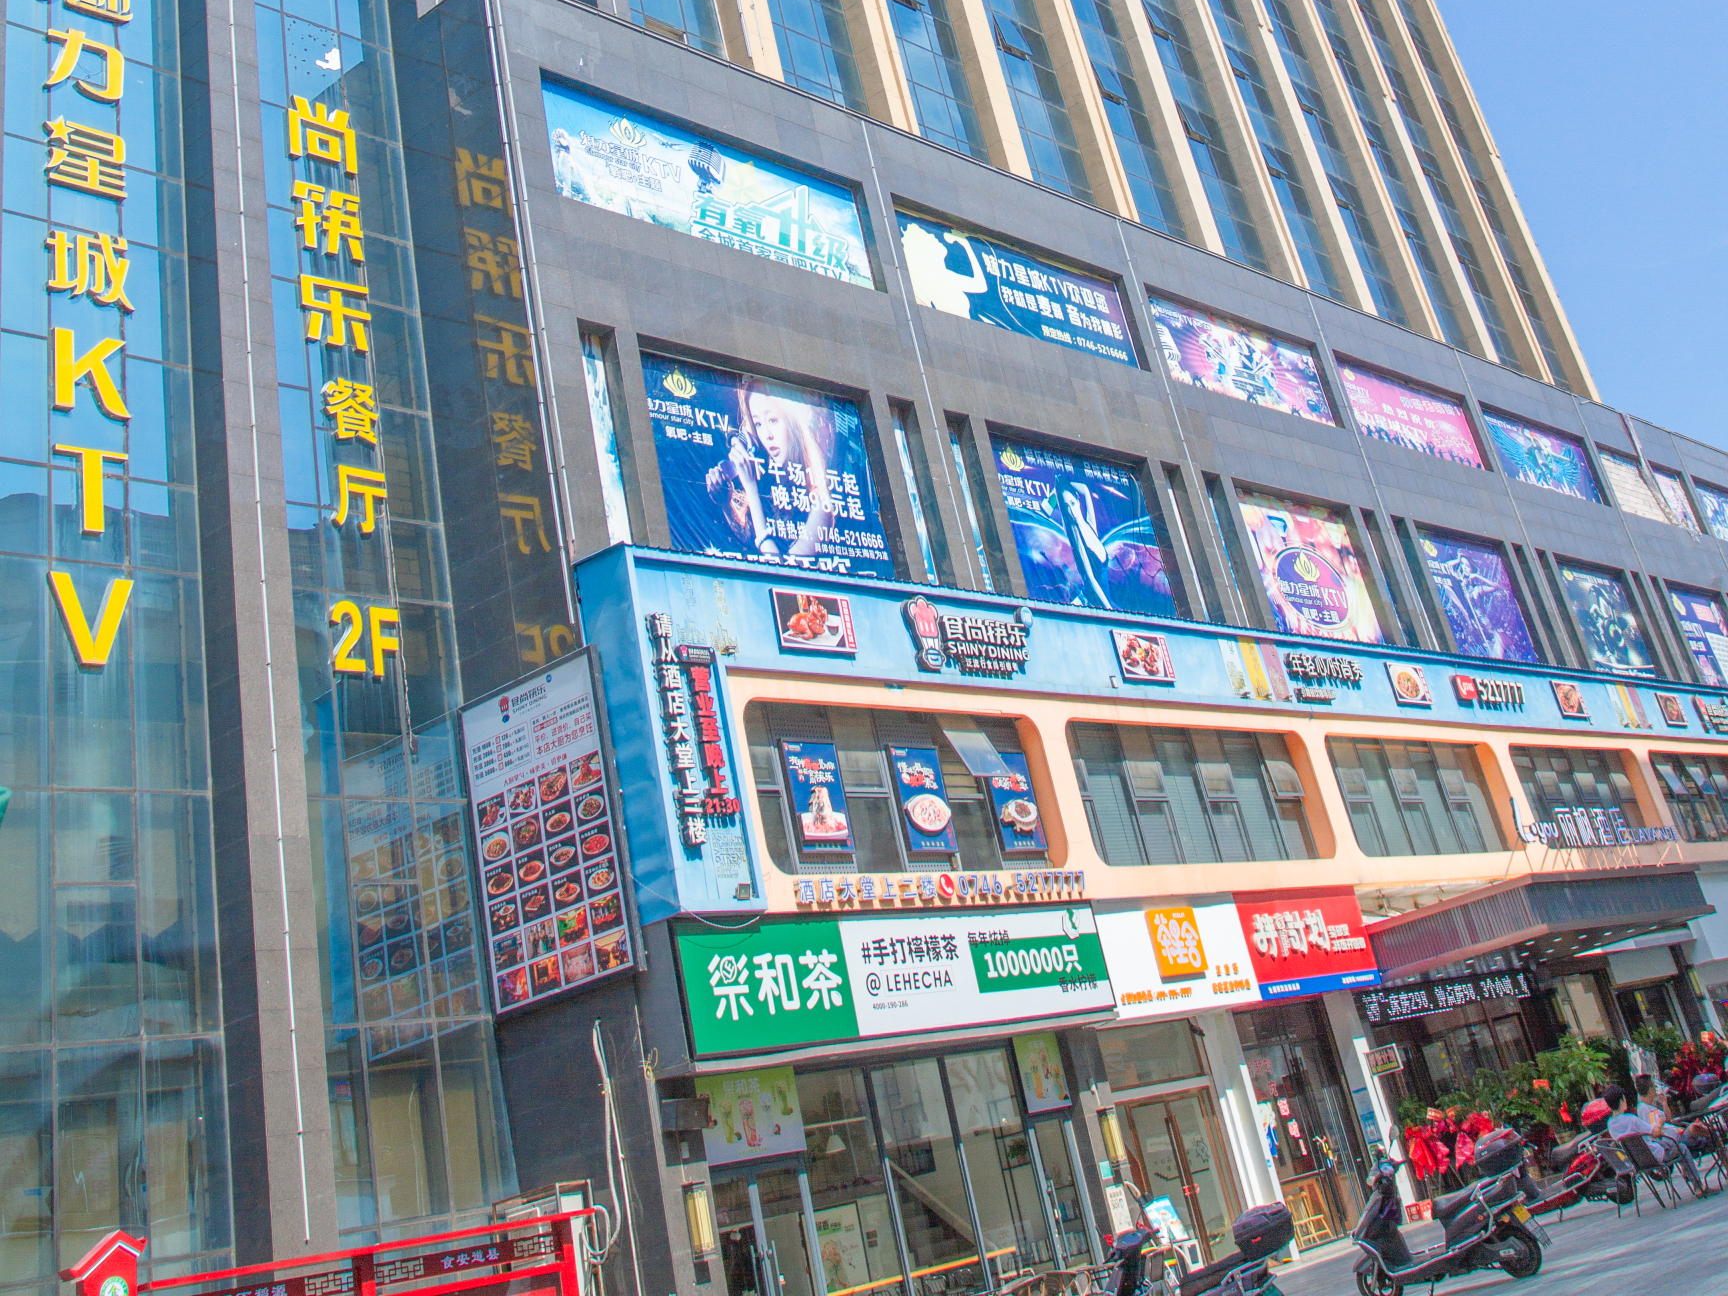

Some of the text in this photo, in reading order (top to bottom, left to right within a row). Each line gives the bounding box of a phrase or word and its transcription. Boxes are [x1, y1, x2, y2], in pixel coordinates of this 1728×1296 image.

[695, 408, 729, 433] KTV
[1025, 478, 1050, 498] KTV
[1322, 587, 1348, 610] KTV
[330, 599, 402, 680] 2F
[943, 615, 1028, 647] 食尚筷乐
[947, 641, 1031, 661] SHINY DINING
[1475, 678, 1527, 705] 5217777
[690, 666, 730, 795] 营业至晚上
[704, 797, 741, 815] 21:30
[1631, 825, 1680, 843] LAVANDE
[798, 870, 1087, 903] 酒店大堂上二楼 0746-5217777
[861, 934, 960, 966] #手打檸檬茶
[967, 930, 1011, 948] 每年炫掉
[440, 1247, 500, 1271] 食安道县
